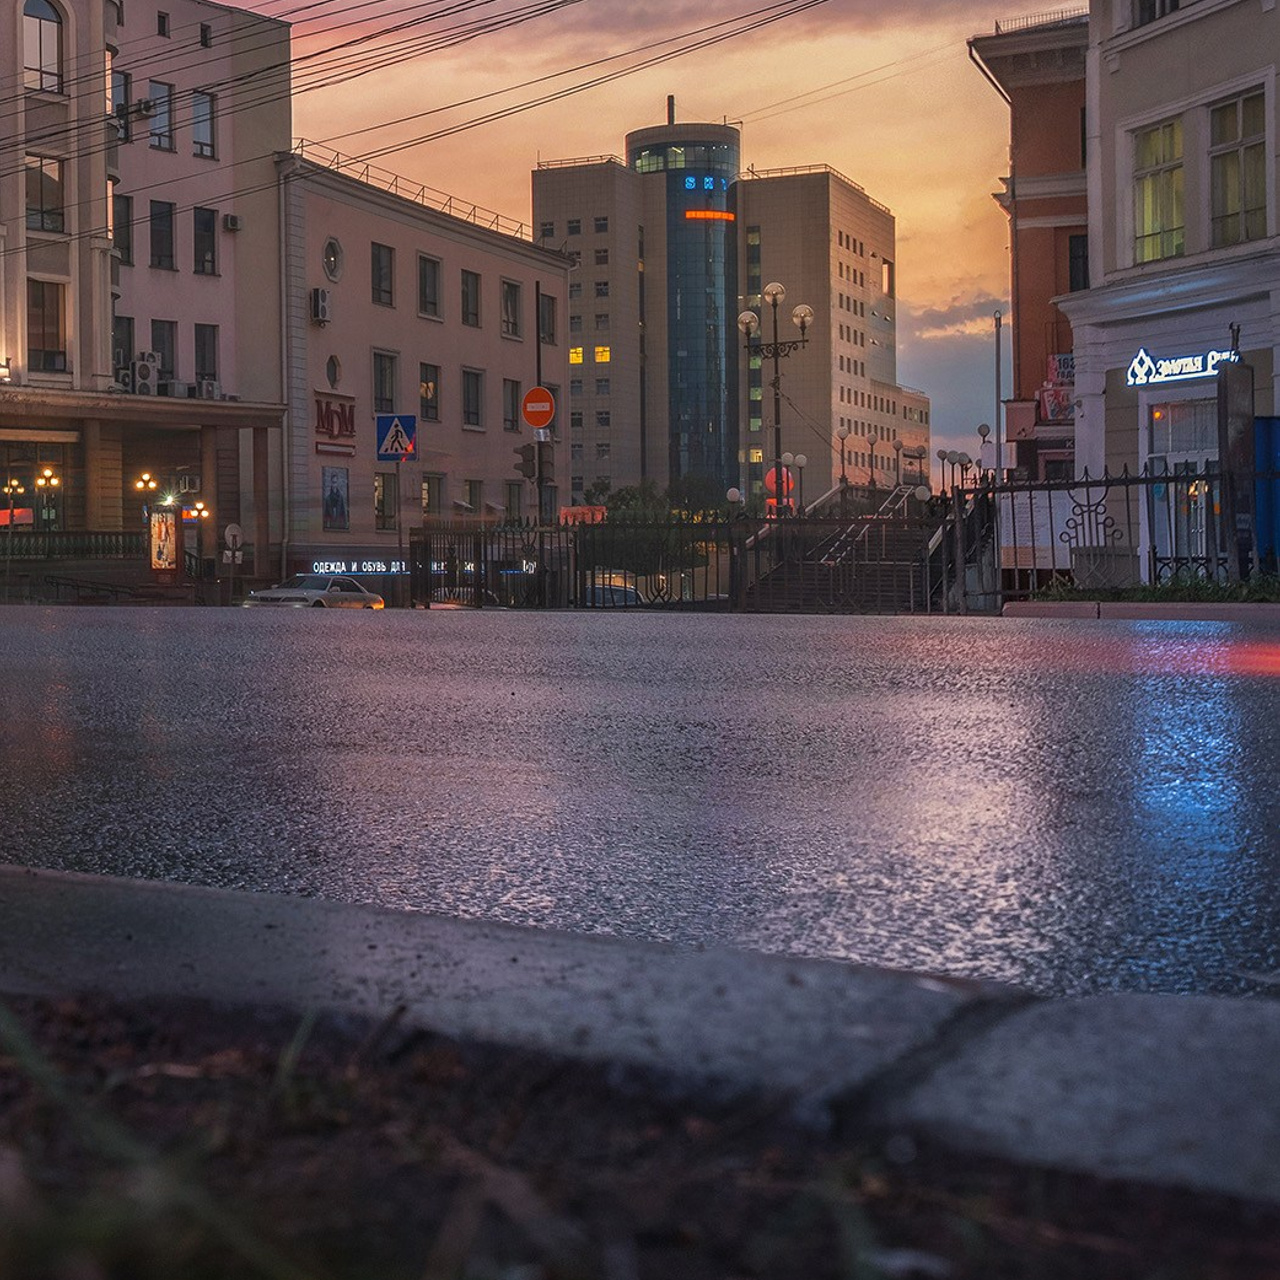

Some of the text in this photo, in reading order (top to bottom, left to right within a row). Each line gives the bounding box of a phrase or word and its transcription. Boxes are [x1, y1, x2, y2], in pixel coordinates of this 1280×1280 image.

[313, 561, 347, 574] ОДЕЖДА
[351, 561, 358, 572] И
[362, 561, 387, 572] ОБУВЬ
